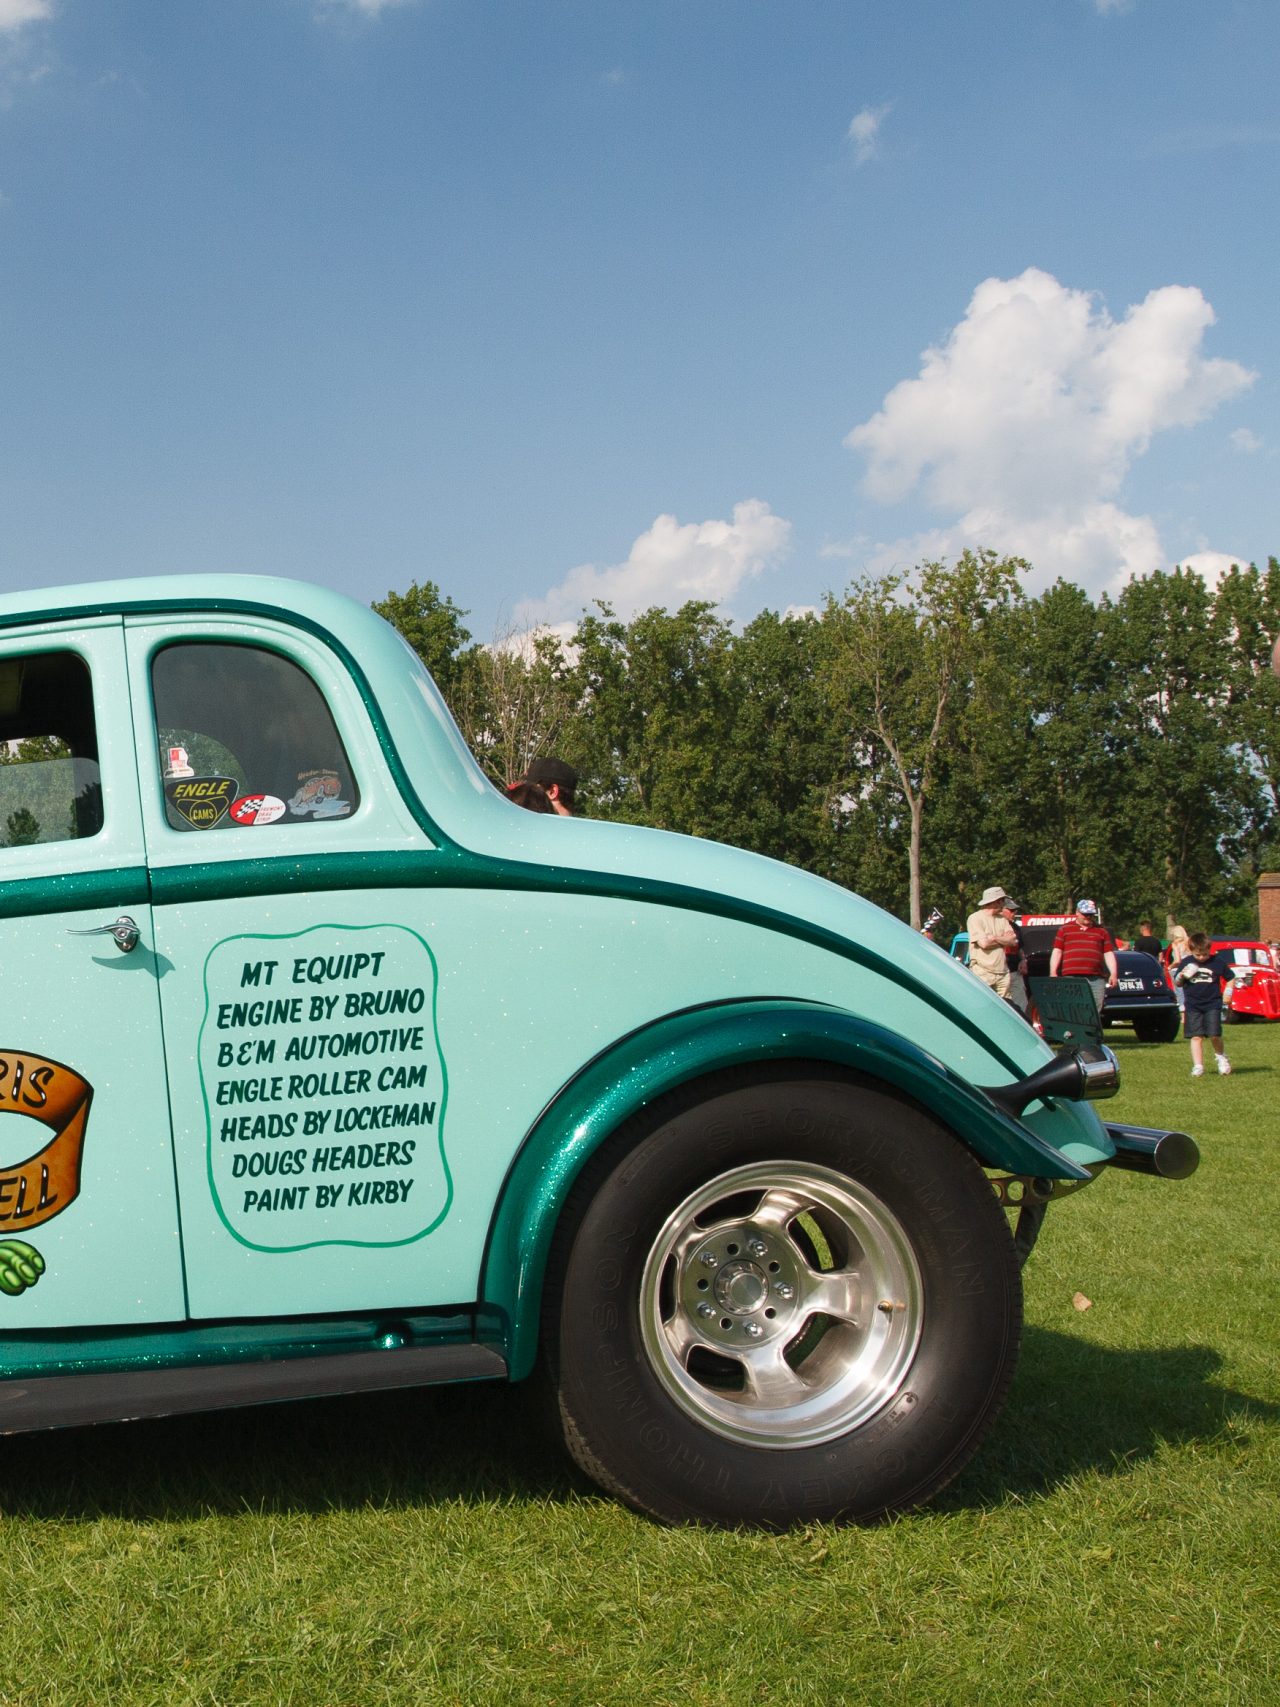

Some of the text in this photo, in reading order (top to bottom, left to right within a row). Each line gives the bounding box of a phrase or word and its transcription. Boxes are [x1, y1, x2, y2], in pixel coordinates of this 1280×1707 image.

[173, 781, 231, 798] ENGLE
[193, 808, 214, 820] CAMS
[240, 952, 385, 988] MT EQUIPT
[216, 988, 425, 1029] ENGINE BY BRUNO
[285, 1027, 424, 1061] AUTOMOTIVE
[216, 1065, 428, 1106] ENGLE ROLLER CAM
[220, 1101, 436, 1142] HEADS BY LOCKEMAN
[232, 1140, 416, 1178] DOUGS HEADERS
[243, 1178, 415, 1213] PAINT BY KIRBY
